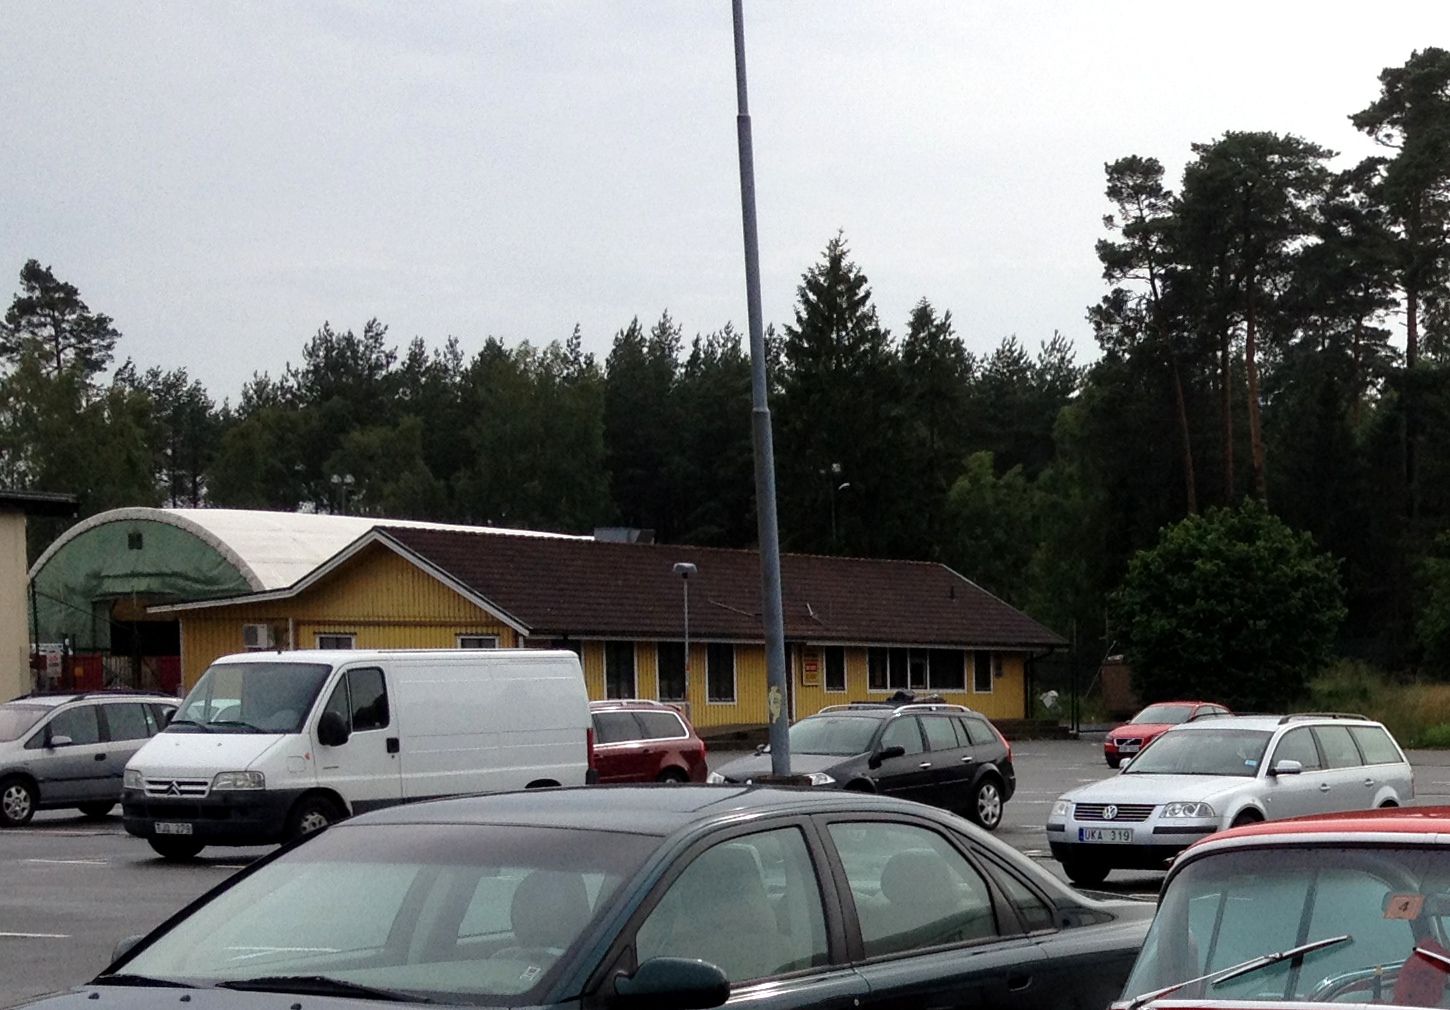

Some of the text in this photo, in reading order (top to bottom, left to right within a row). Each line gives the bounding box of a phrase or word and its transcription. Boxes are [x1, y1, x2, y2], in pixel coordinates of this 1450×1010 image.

[1085, 830, 1130, 841] UKA 319
[1399, 902, 1409, 912] 4
